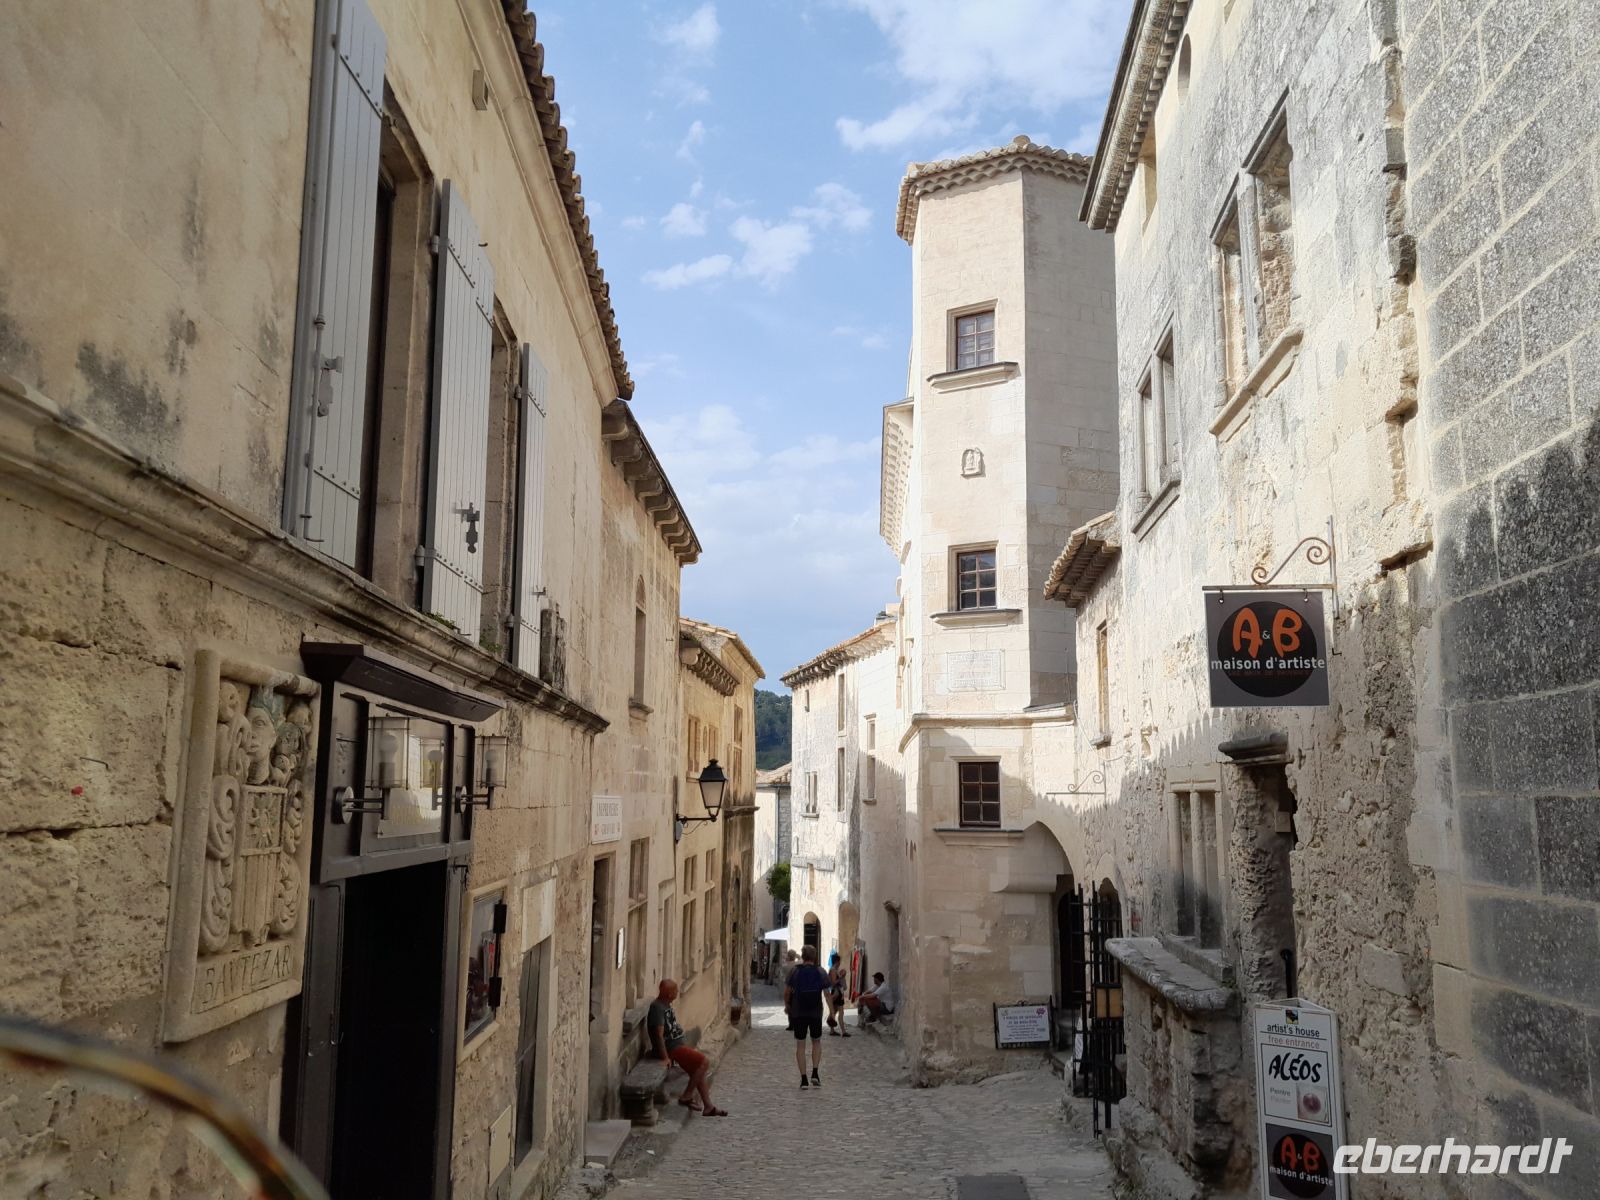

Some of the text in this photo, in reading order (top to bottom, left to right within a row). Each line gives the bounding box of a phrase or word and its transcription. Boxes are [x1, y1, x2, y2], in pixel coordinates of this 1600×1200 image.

[1211, 656, 1326, 670] maison d'artiste
[1267, 1023, 1320, 1038] artist's house
[1268, 1034, 1320, 1049] free entrance
[1269, 1165, 1334, 1186] maison d'artiste
